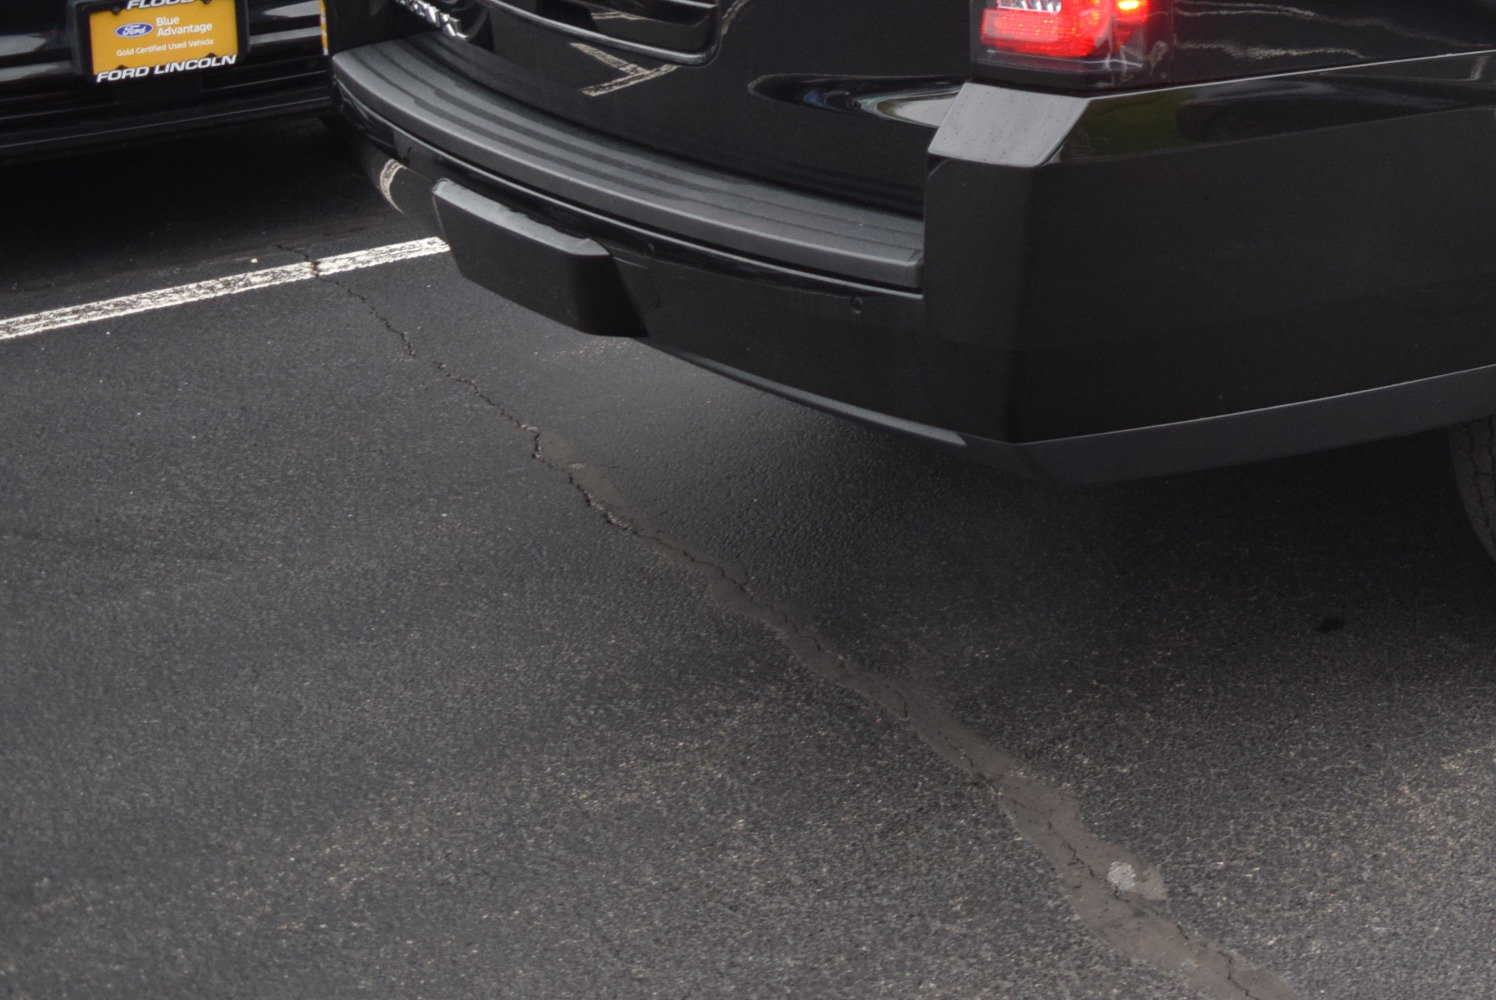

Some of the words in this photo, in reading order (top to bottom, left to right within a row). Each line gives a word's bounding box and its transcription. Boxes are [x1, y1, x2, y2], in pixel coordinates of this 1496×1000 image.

[155, 16, 180, 27] Blue
[121, 23, 148, 36] Ford
[157, 23, 213, 37] Advantage
[116, 48, 135, 57] Gold
[135, 44, 167, 55] Certified
[168, 41, 187, 50] Used
[188, 38, 214, 48] Vehicle
[96, 65, 150, 83] FORD
[153, 54, 237, 75] LINCOLN
